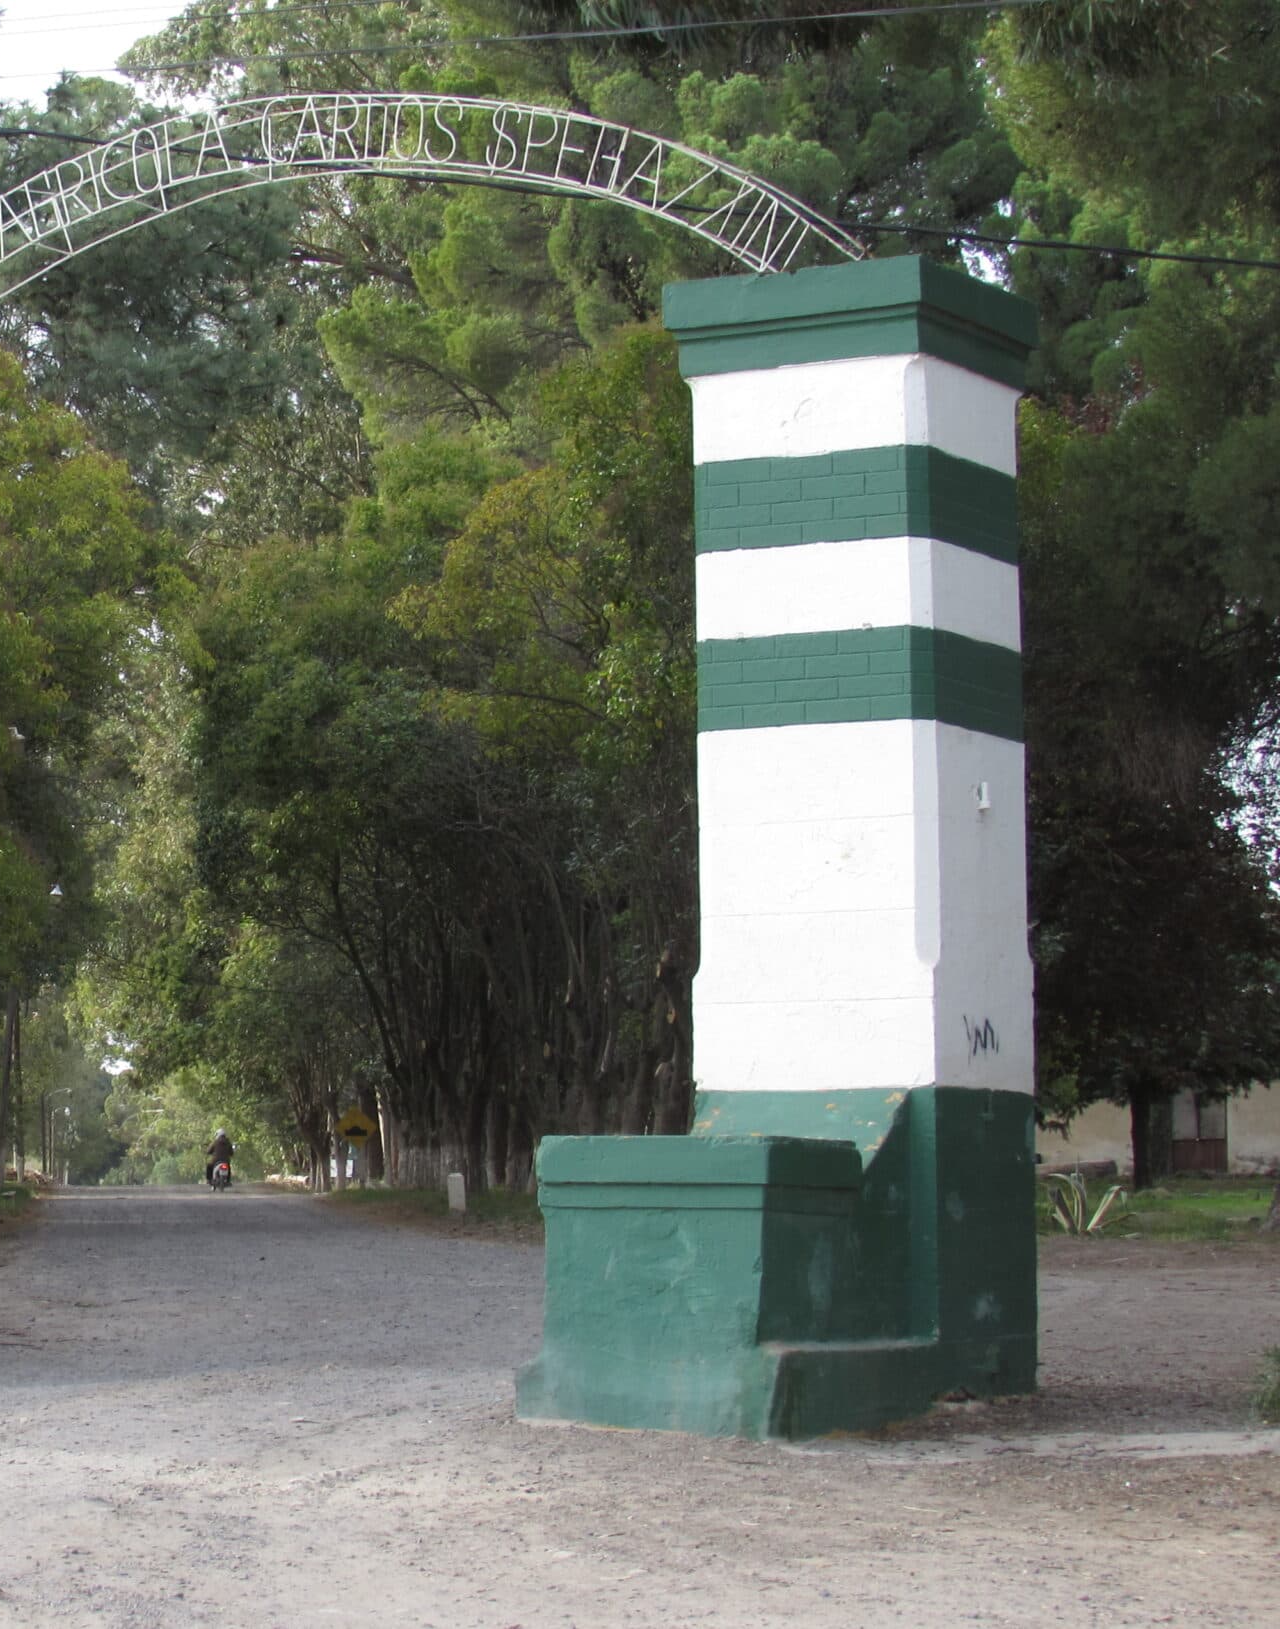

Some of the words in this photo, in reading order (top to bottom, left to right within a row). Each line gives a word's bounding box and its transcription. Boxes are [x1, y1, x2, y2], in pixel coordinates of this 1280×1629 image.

[0, 112, 231, 259] AGRICOLA
[261, 95, 463, 163] CARLOS
[485, 102, 811, 273] SPEGAZZINI
